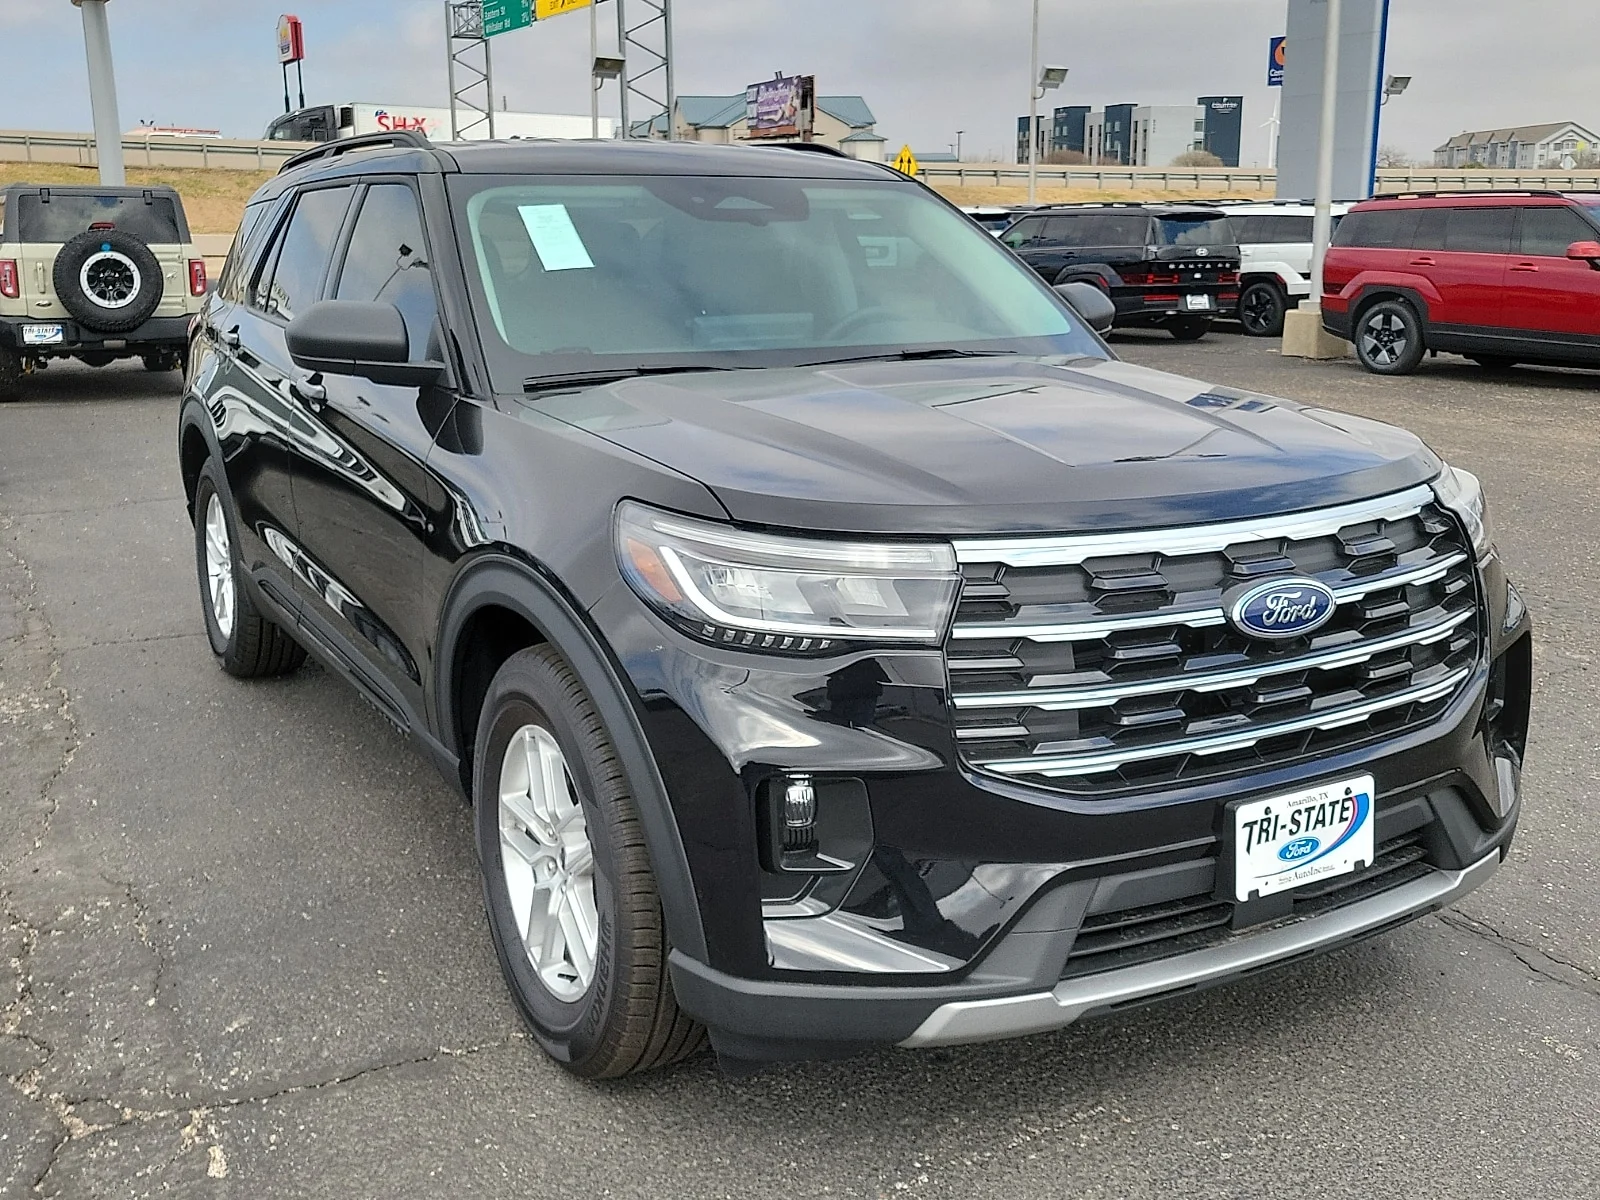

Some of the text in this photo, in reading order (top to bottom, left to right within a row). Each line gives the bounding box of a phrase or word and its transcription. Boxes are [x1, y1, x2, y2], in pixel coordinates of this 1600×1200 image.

[1168, 262, 1212, 270] SANTA
[1262, 591, 1317, 627] Ford
[1318, 791, 1329, 801] TX
[1241, 796, 1354, 856] TRI-STATE
[1285, 840, 1313, 860] Ford
